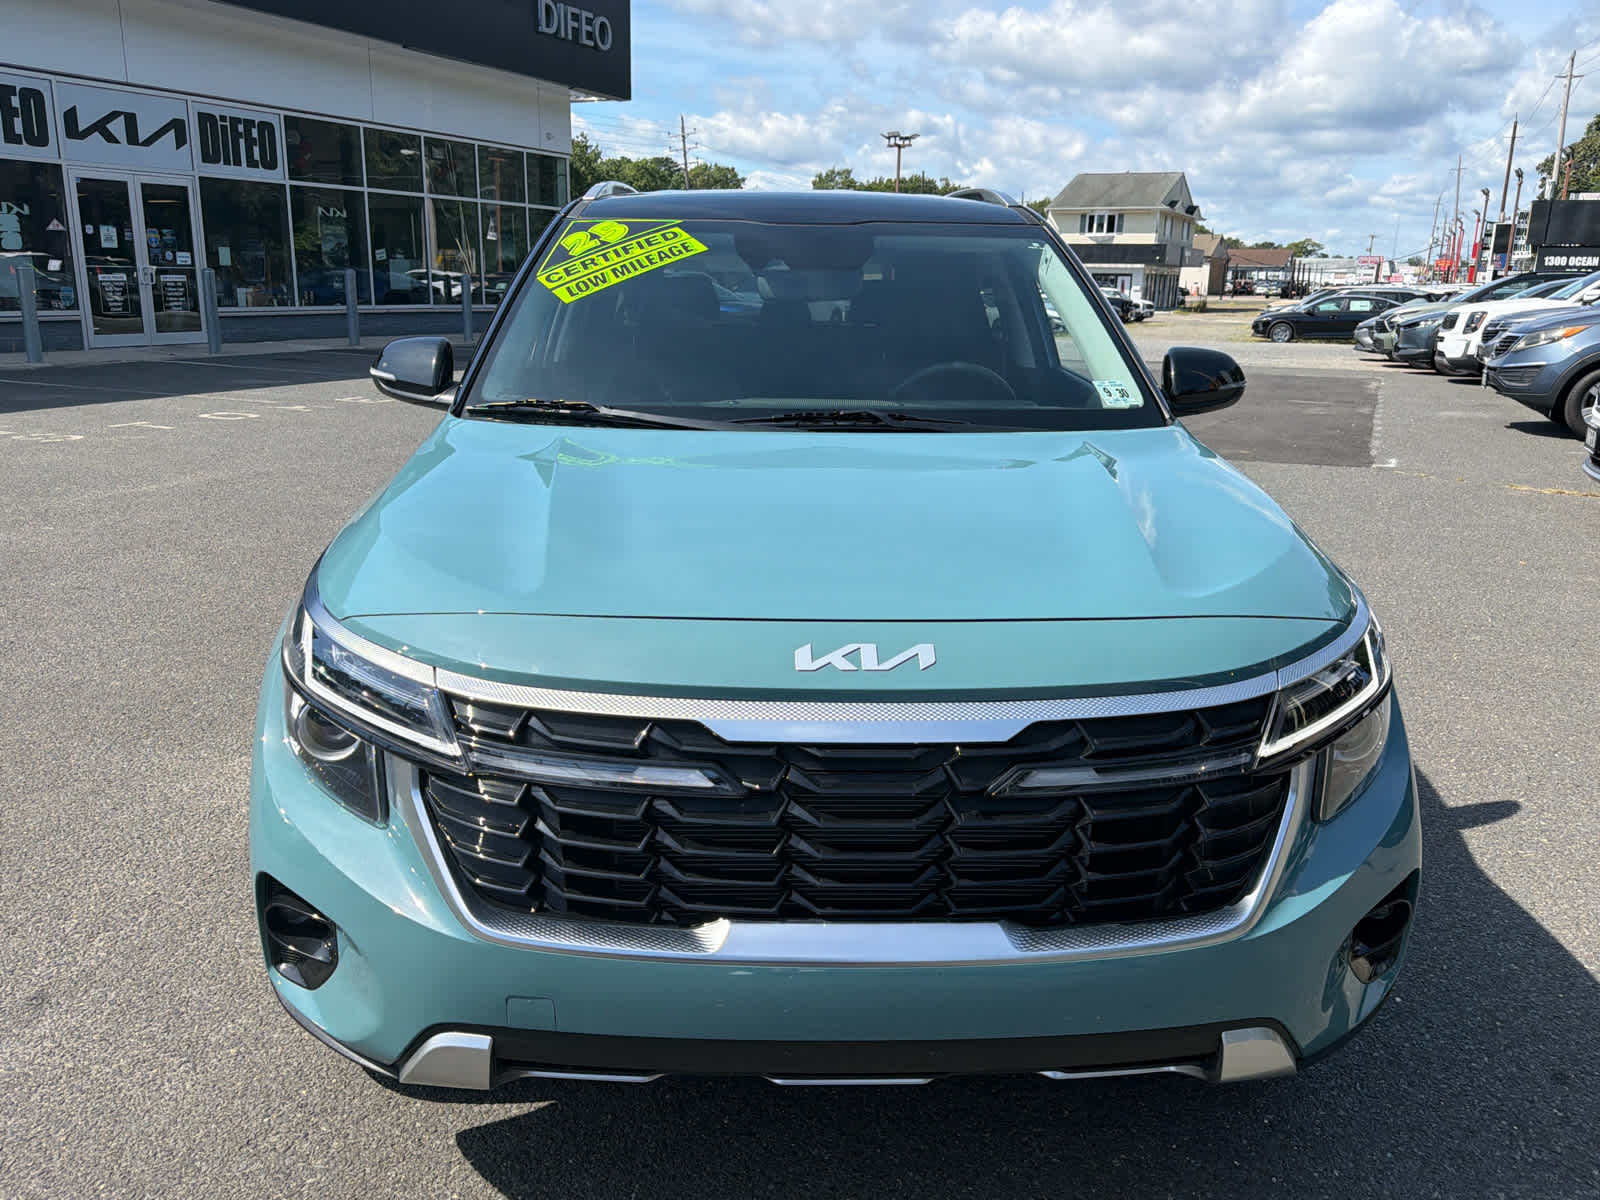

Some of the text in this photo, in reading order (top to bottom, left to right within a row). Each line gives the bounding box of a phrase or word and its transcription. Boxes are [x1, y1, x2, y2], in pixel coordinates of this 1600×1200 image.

[538, 0, 612, 51] DIFEO
[63, 104, 188, 150] KIA
[544, 230, 680, 284] CERTIFIED
[565, 241, 696, 298] LOW MILEAGE
[1544, 256, 1600, 268] 1300 OCEAN
[794, 643, 937, 671] KIA
